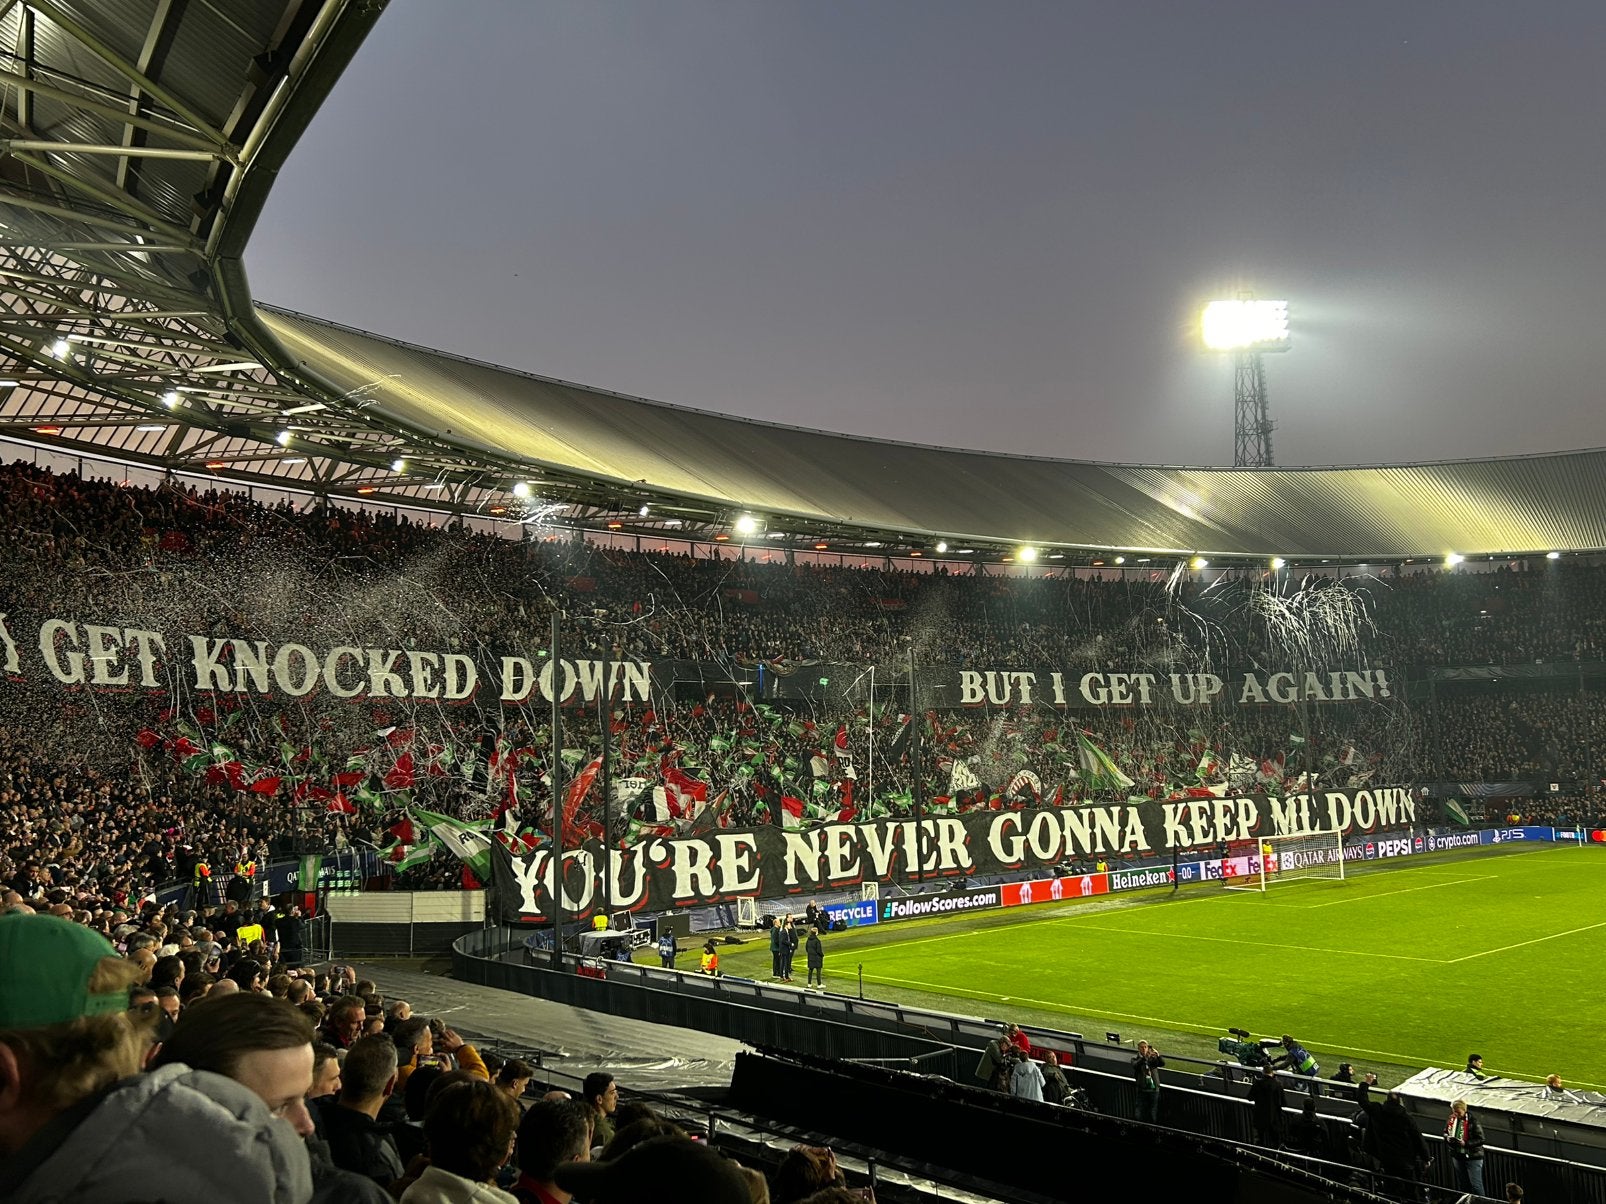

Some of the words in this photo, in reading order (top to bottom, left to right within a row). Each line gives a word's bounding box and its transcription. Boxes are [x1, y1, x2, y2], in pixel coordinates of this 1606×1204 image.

[39, 619, 166, 687] GET
[189, 634, 478, 700] KNOCKED
[500, 656, 652, 702] DOWN
[959, 670, 1037, 704] BUT
[1053, 672, 1066, 704] I
[1079, 672, 1158, 704] GET
[1169, 673, 1224, 703] UP
[1239, 670, 1392, 703] AGAIN!
[782, 818, 972, 885] NEVER
[987, 806, 1151, 864] GONNA
[1162, 799, 1259, 848] KEEP
[1325, 788, 1416, 831] DOWN
[1437, 834, 1478, 850] crypto.com
[1378, 839, 1412, 858] PEPSI
[1247, 854, 1279, 874] FeEx
[1294, 850, 1326, 868] QATAR
[1112, 870, 1167, 889] Heineken
[1204, 861, 1238, 879] FedEx
[828, 905, 873, 922] RECYCLE
[891, 893, 996, 917] FollowScores.com
